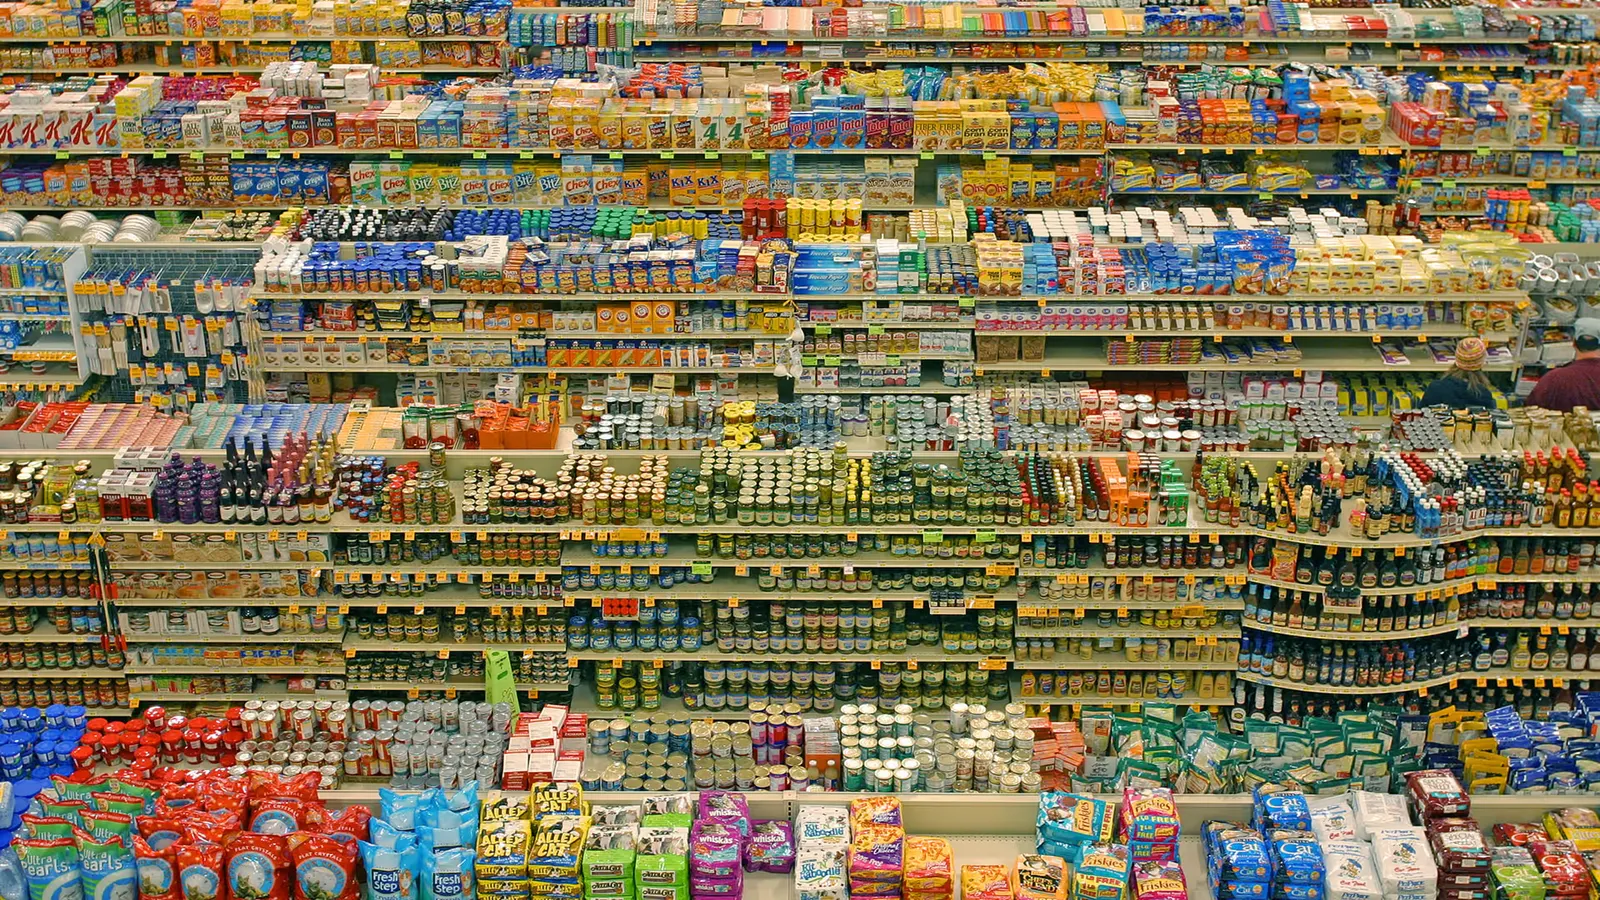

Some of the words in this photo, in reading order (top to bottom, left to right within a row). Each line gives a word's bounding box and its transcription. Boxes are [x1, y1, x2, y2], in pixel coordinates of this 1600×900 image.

[888, 49, 915, 57] GIANT
[70, 112, 94, 146] K
[703, 122, 718, 140] 4
[728, 122, 742, 140] 4
[770, 120, 789, 132] Total
[790, 120, 813, 133] Total
[815, 118, 838, 132] Total
[840, 118, 865, 132] Total
[867, 118, 888, 132] Total
[891, 118, 913, 132] Total
[939, 123, 961, 131] FIBER
[95, 119, 118, 146] K
[353, 169, 376, 182] Chex
[383, 178, 406, 191] Chex
[463, 180, 484, 191] Chex
[489, 180, 510, 192] Chex
[566, 177, 590, 191] Chex
[595, 178, 619, 191] Chex
[827, 274, 843, 282] Paper
[827, 285, 843, 293] Paper
[67, 791, 91, 801] Ultra
[536, 791, 576, 804] ALLEY
[485, 807, 527, 820] ALLEY
[540, 801, 569, 813] CAT
[1136, 801, 1171, 817] Friskies
[708, 810, 742, 818] whiskas
[1077, 801, 1090, 833] Friskies
[1103, 804, 1114, 824] FREE
[1151, 816, 1176, 824] FREE
[537, 831, 577, 844] ALLEY
[752, 834, 786, 844] whiskas
[804, 828, 844, 839] Kaboodle
[1137, 831, 1154, 840] FREE
[481, 834, 526, 847] ALLEY
[699, 836, 734, 846] whiskas
[234, 845, 250, 853] FLAT
[250, 845, 279, 861] CRYSTALS
[484, 845, 513, 858] CAT
[537, 843, 569, 858] CAT
[1134, 850, 1150, 858] FREE
[1226, 841, 1260, 854] Cat
[1280, 841, 1313, 855] Cat
[26, 855, 53, 867] Ultra
[83, 849, 107, 860] Ultra
[299, 851, 314, 860] FLAT
[314, 851, 343, 864] CRYSTALS
[20, 858, 68, 877] Pearls
[800, 867, 842, 880] Kaboodle
[801, 862, 816, 872] Kit
[1240, 867, 1255, 878] Cat
[1496, 866, 1528, 878] Cat
[372, 870, 399, 884] Fresh
[433, 873, 461, 886] Fresh
[1096, 875, 1122, 887] FREE
[373, 880, 399, 893] Step
[434, 882, 462, 896] Step
[1139, 880, 1182, 894] Friskies
[1079, 889, 1098, 898] FREE
